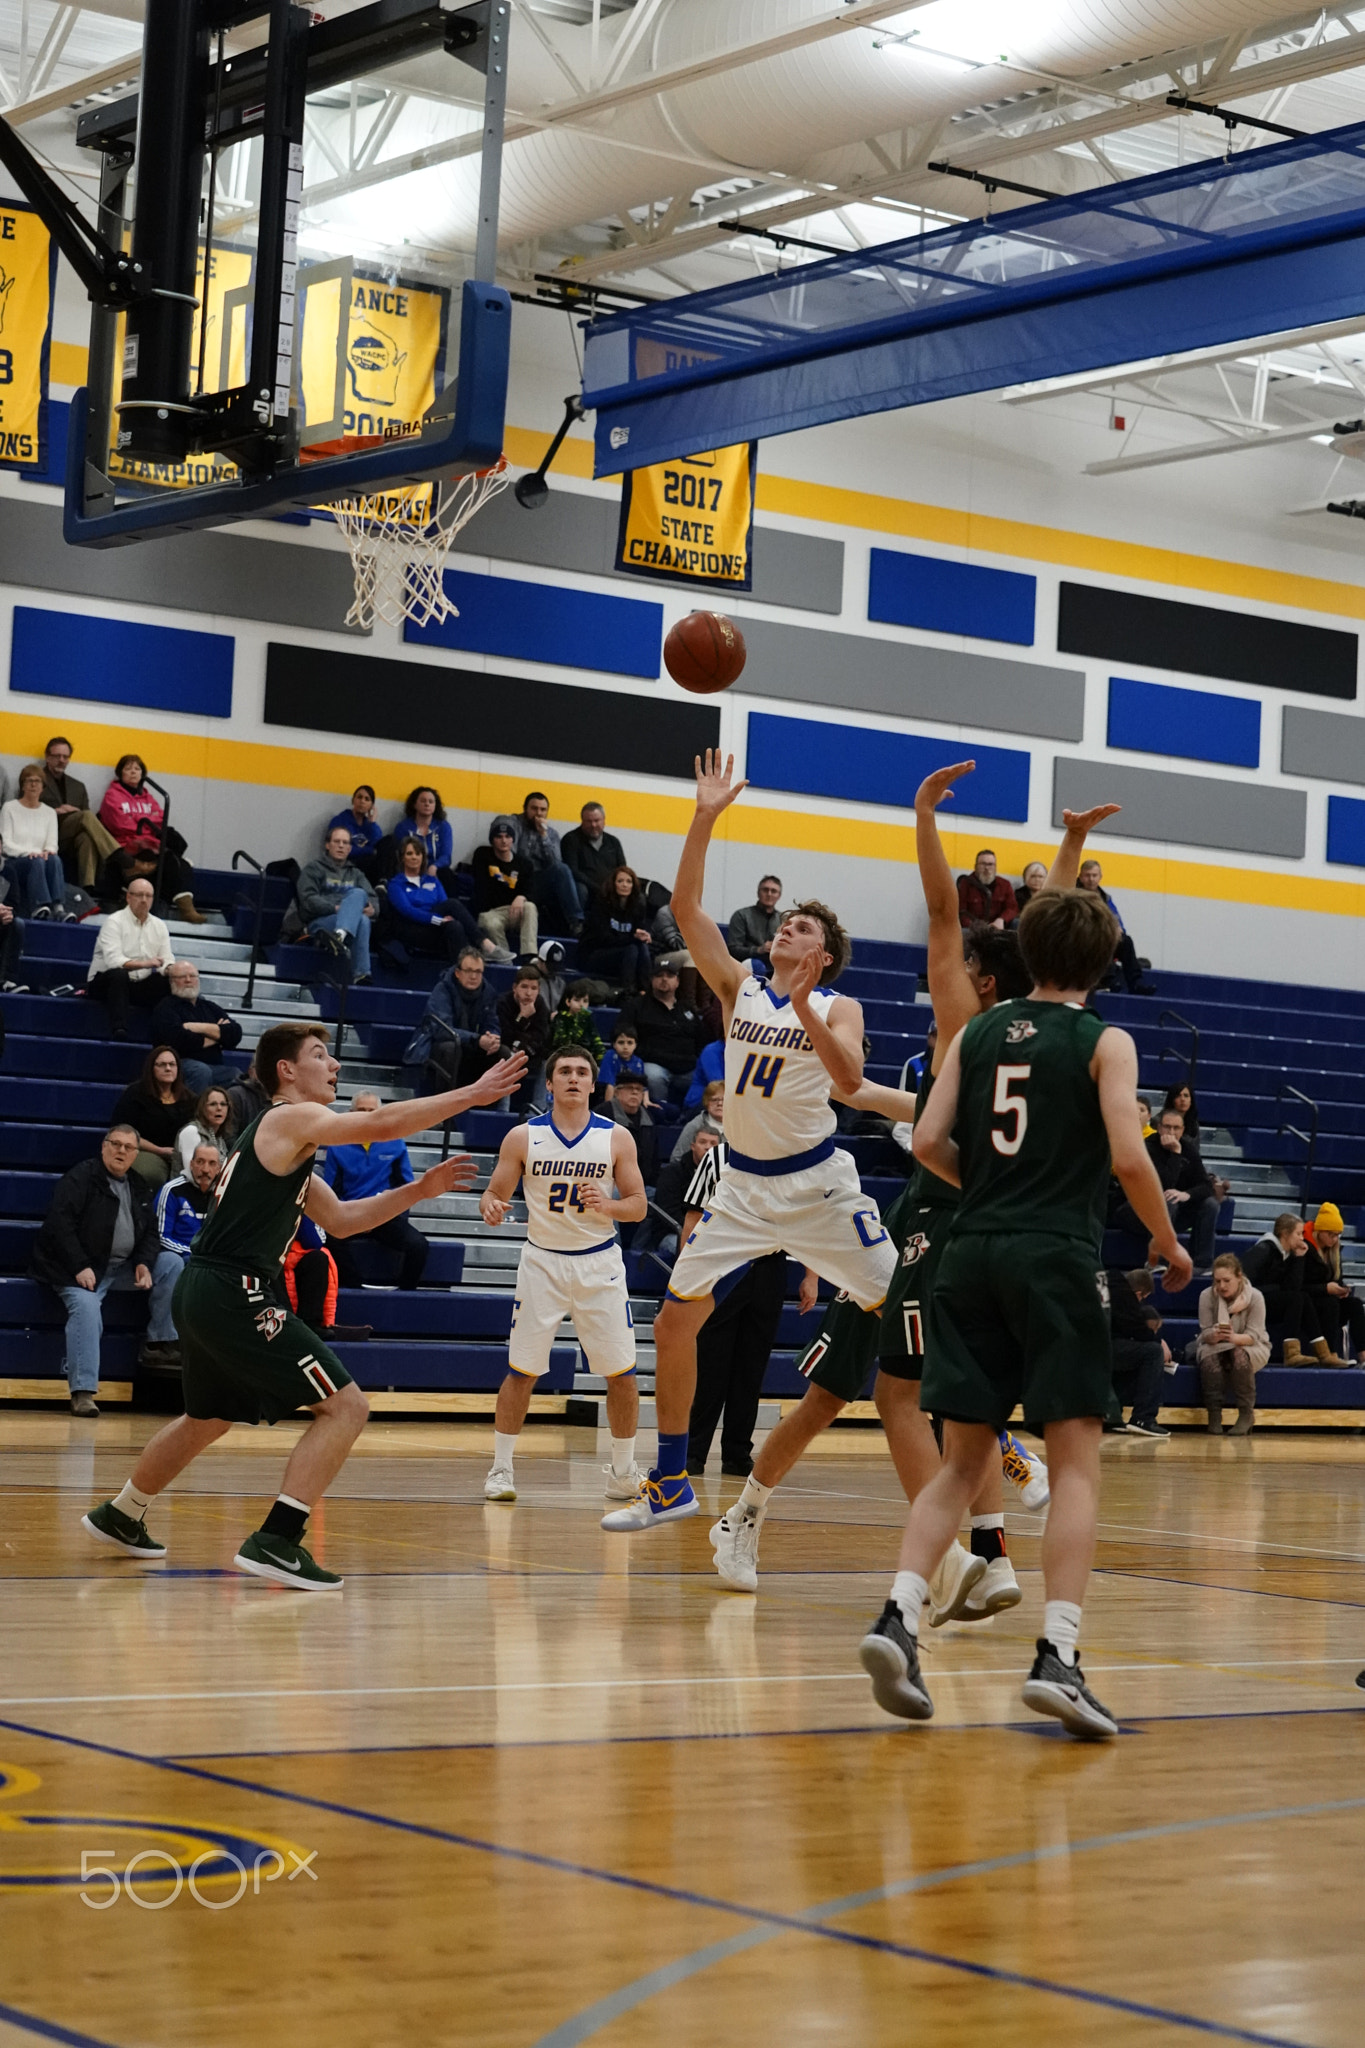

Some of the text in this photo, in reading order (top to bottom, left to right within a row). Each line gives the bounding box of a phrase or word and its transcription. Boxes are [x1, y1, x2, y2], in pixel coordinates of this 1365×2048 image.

[350, 285, 409, 318] ANCE
[664, 470, 723, 512] 2017
[661, 515, 714, 546] STATE
[629, 538, 743, 576] CHAMPIONS
[734, 1052, 786, 1099] 14
[991, 1063, 1032, 1157] 5
[531, 1160, 608, 1179] COUGARS
[548, 1181, 590, 1214] 24
[852, 1208, 889, 1249] C
